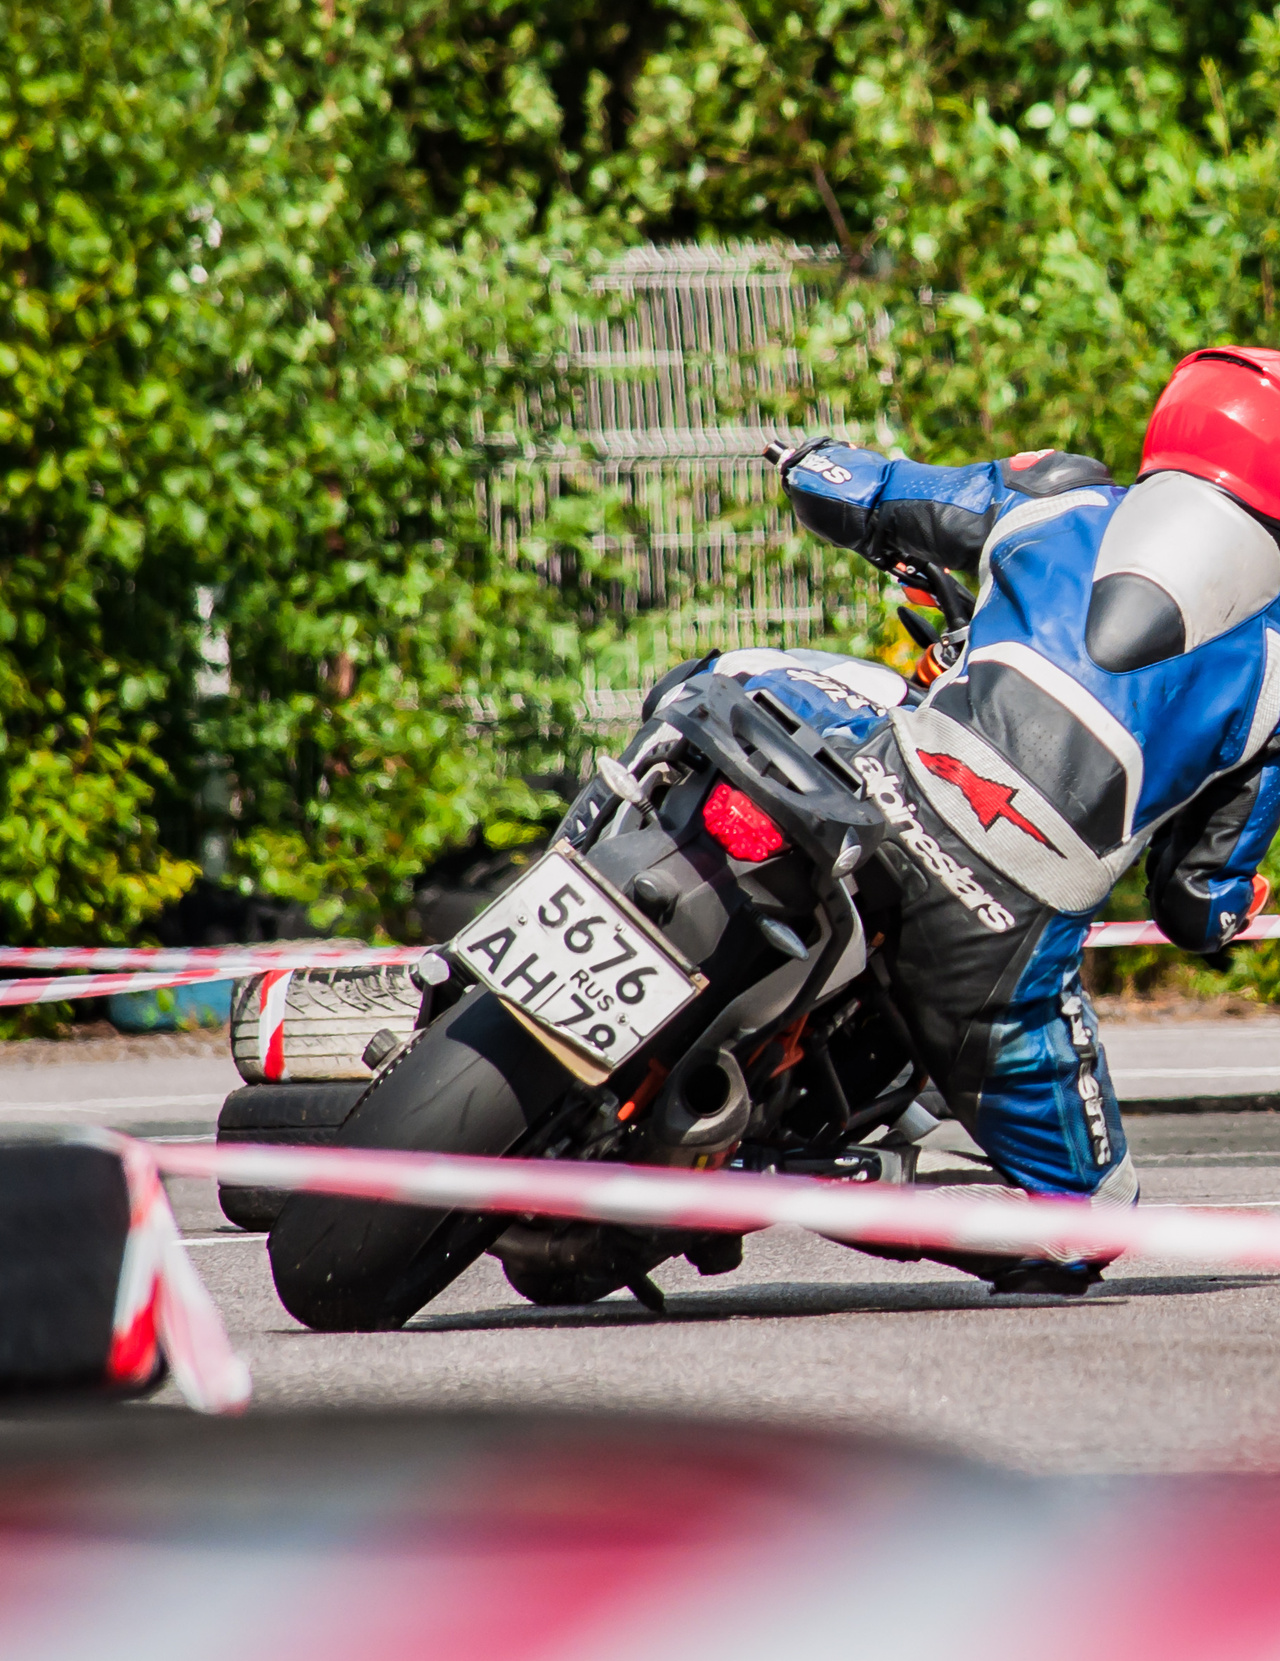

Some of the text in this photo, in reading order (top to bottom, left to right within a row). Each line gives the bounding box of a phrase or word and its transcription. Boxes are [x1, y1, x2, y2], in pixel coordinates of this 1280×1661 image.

[853, 756, 1016, 932] alpinestars
[466, 926, 558, 1005] AH
[538, 883, 659, 1005] 5676
[569, 968, 615, 1012] RUS
